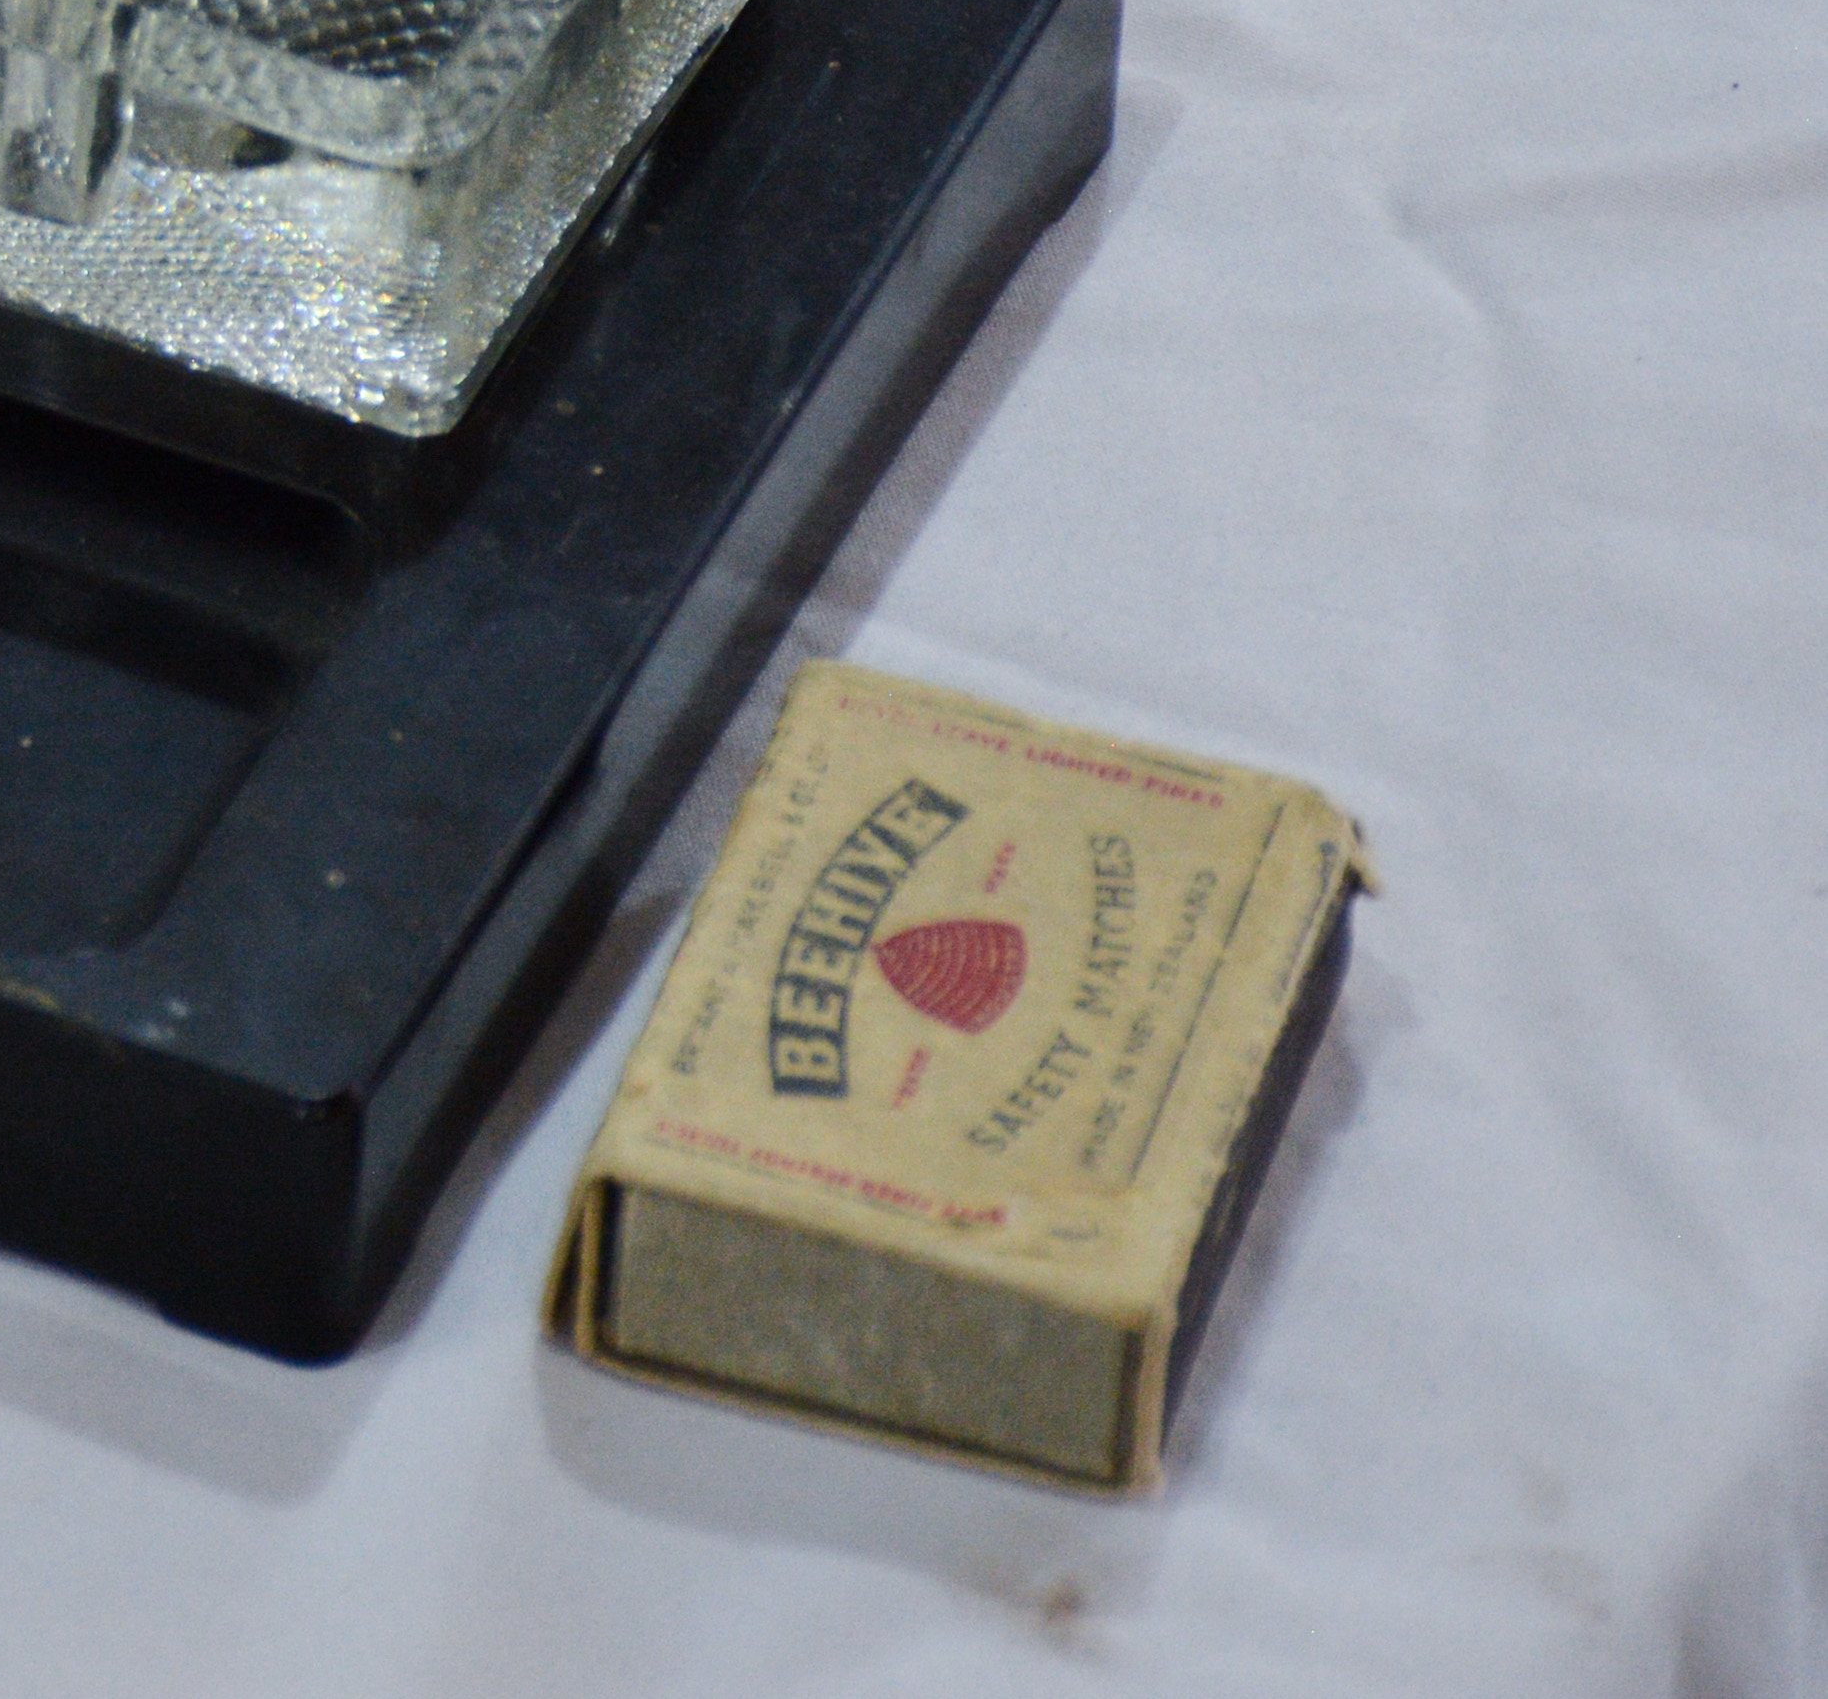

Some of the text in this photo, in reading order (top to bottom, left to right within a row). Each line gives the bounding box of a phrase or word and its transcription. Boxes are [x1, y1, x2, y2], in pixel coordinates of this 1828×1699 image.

[771, 786, 958, 1083] BEEHIVE
[966, 1030, 1091, 1152] SAFETY
[1073, 834, 1136, 1019] MATCHES
